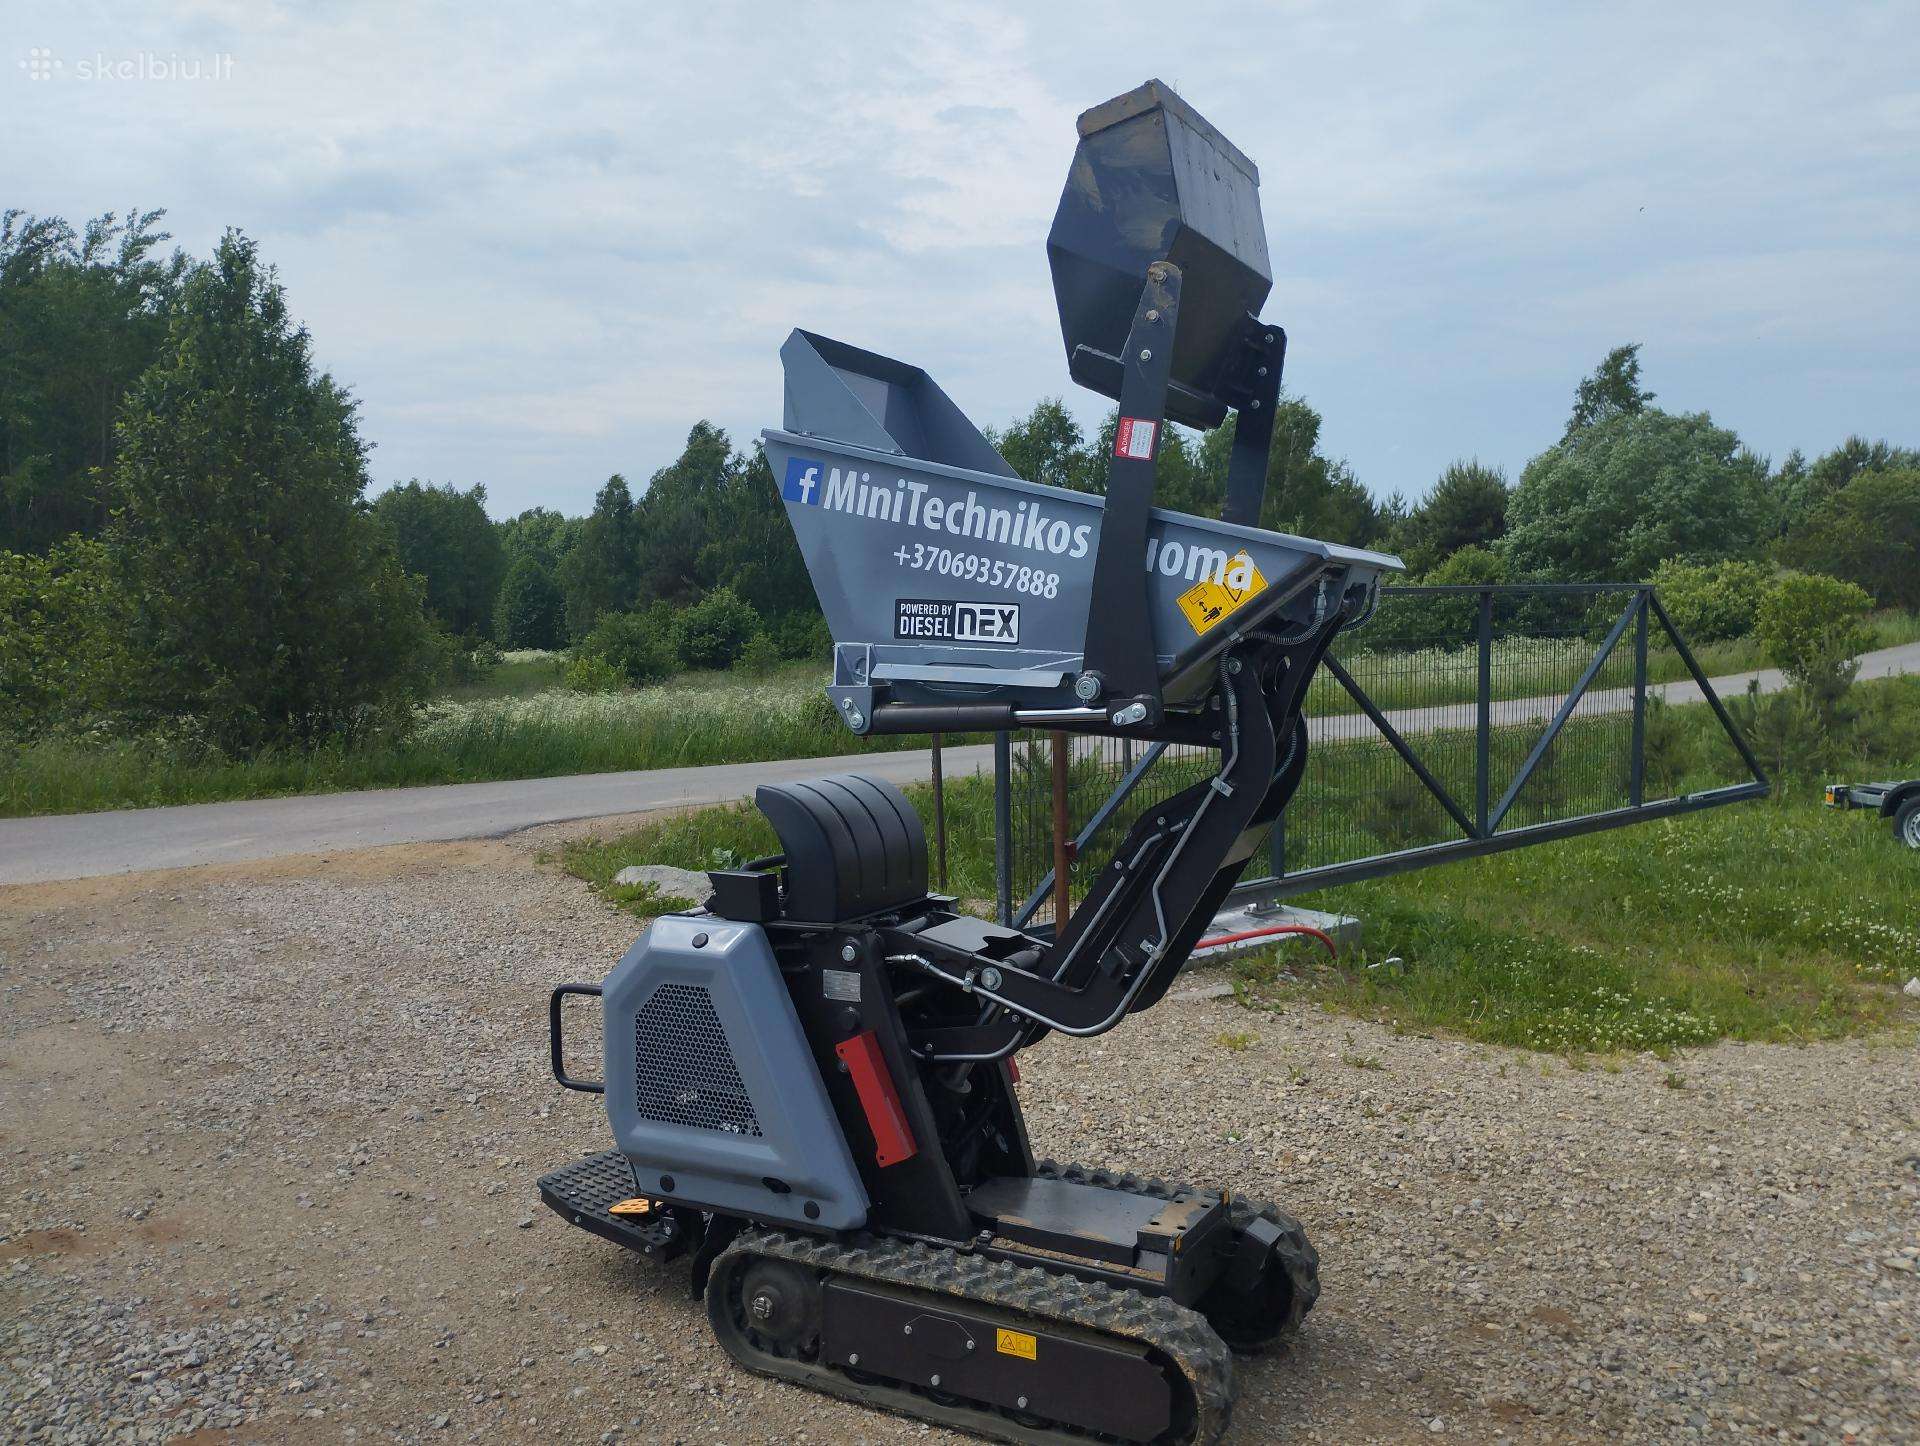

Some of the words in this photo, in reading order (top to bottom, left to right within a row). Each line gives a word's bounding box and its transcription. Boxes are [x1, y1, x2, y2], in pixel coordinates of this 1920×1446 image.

[823, 467, 1092, 559] MiniTechnikos
[1146, 538, 1255, 592] oma
[893, 543, 1060, 600] +37069357888
[899, 616, 952, 638] DIESEL
[900, 602, 939, 615] POWERED
[941, 605, 952, 616] BY
